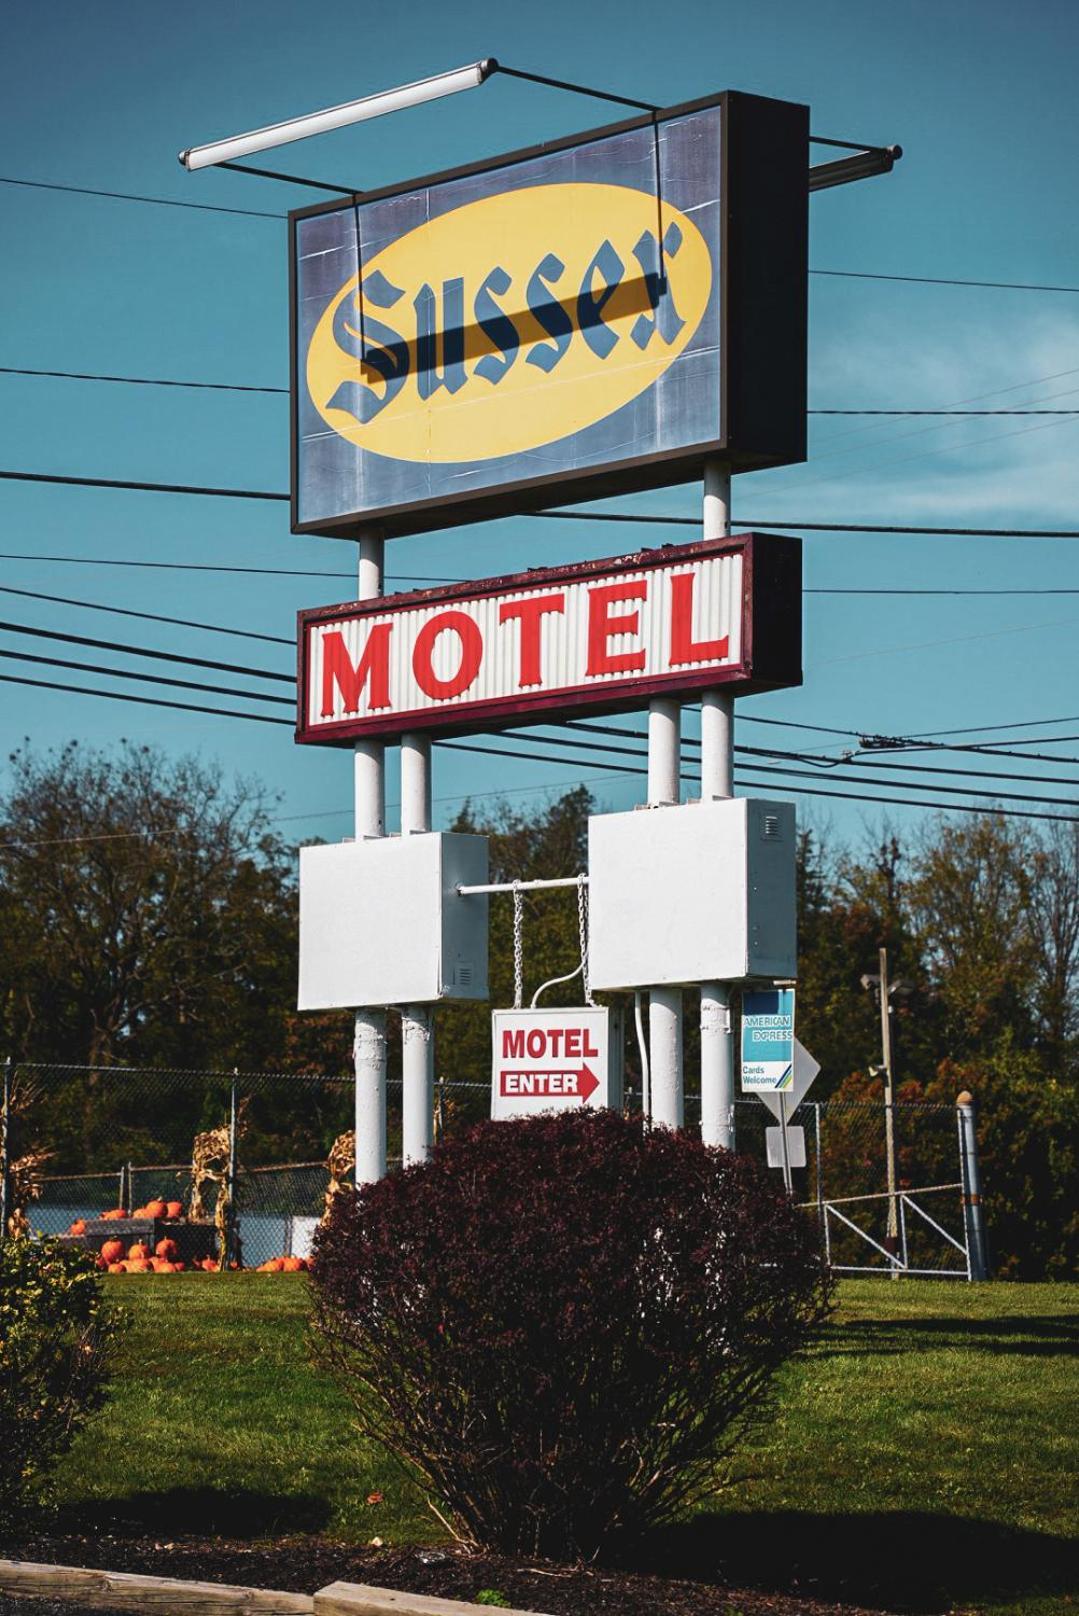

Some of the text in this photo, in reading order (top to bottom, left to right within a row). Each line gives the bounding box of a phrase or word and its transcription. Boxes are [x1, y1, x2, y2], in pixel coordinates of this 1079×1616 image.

[321, 572, 729, 718] MOTEL
[744, 1016, 790, 1026] AMERICAN
[753, 1030, 792, 1040] EXPRESS
[502, 1028, 598, 1058] MOTEL
[743, 1066, 764, 1074] Cards
[505, 1074, 578, 1093] ENTER
[743, 1076, 777, 1084] Welcome
